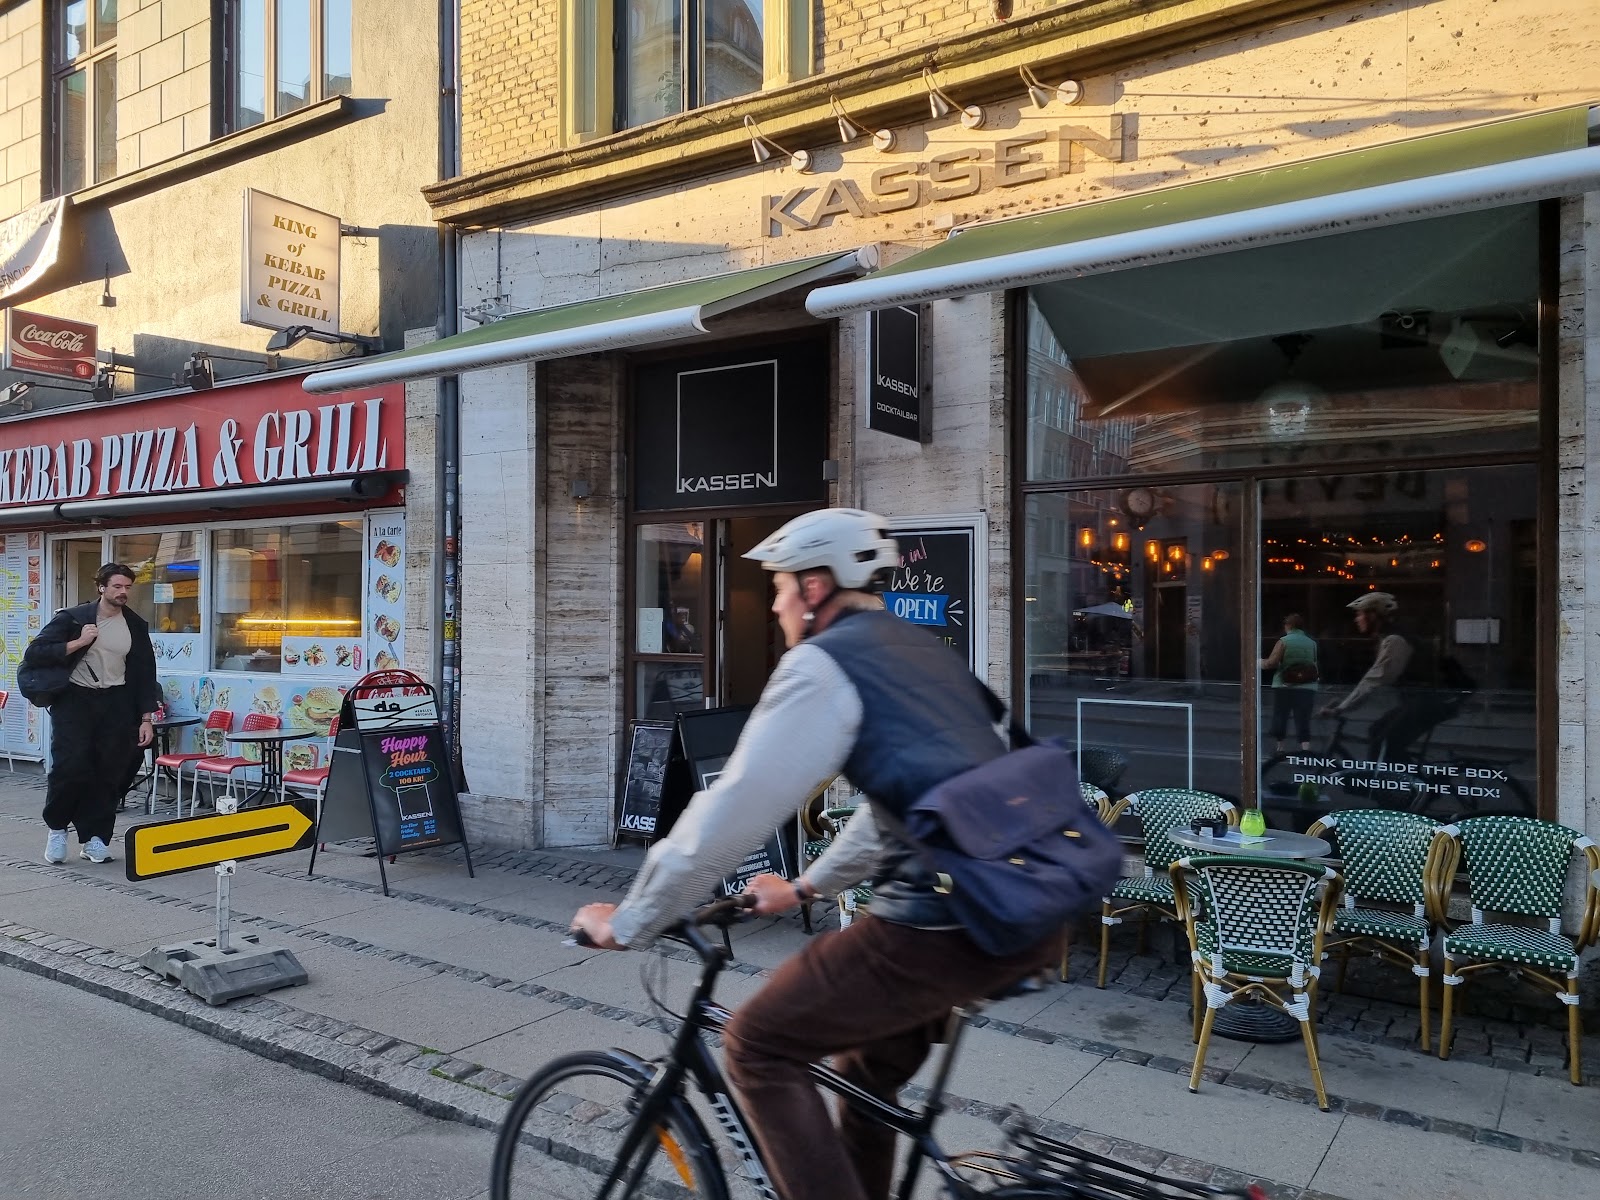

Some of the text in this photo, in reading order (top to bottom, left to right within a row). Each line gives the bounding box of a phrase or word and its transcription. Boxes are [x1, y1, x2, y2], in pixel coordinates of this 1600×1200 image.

[761, 112, 1123, 238] KASSEN
[272, 214, 317, 239] KING
[287, 243, 306, 257] of
[263, 253, 326, 281] KEBAB
[267, 275, 322, 300] PIZZA
[256, 293, 331, 322] & GRILL
[19, 323, 88, 352] Coca-Cola
[877, 374, 918, 398] KASSEN
[876, 401, 918, 422] COCKTAILBAR
[0, 397, 388, 504] KEBAB PIZZA & GRILL
[678, 471, 776, 493] KASSEN
[373, 527, 378, 537] A
[387, 526, 402, 536] Carte
[891, 566, 945, 592] We're
[894, 597, 938, 620] OPEN
[381, 735, 428, 753] Happy
[391, 750, 427, 767] Hour
[1286, 755, 1508, 782] THINK OUTSIDE THE BOX,
[395, 767, 431, 777] COCKTAILS
[1293, 773, 1500, 798] DRINK INSIDE THE BOX!
[402, 811, 432, 821] KASSEN
